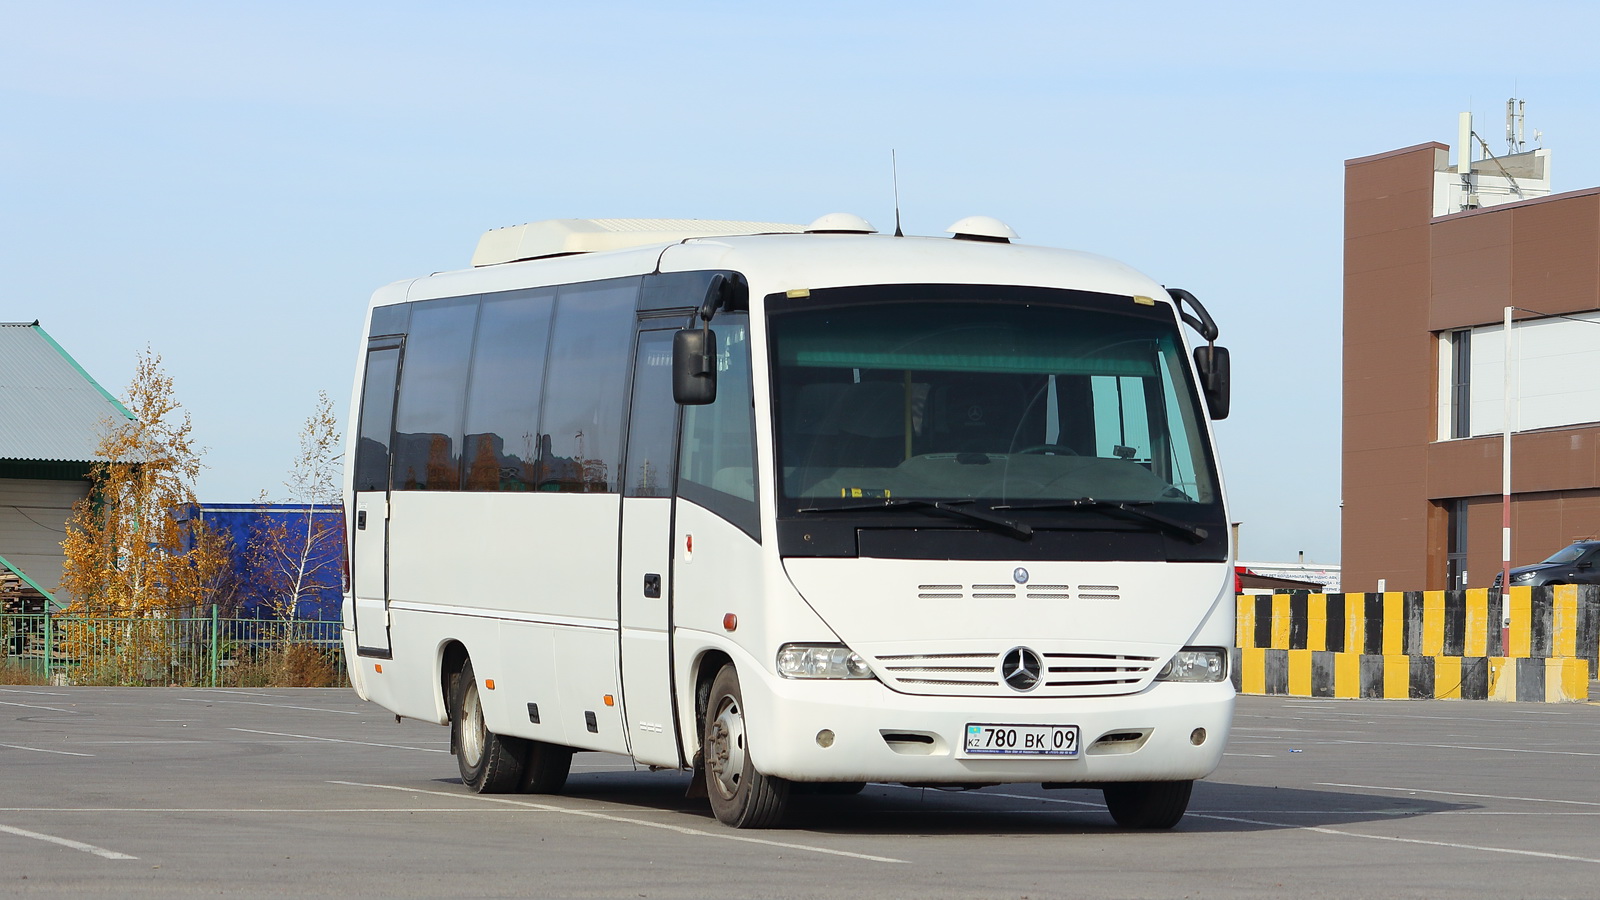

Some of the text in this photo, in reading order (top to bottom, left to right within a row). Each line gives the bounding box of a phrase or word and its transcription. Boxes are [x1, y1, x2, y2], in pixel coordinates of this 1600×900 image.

[968, 739, 980, 747] KZ
[984, 728, 1075, 748] 780 BK 09
